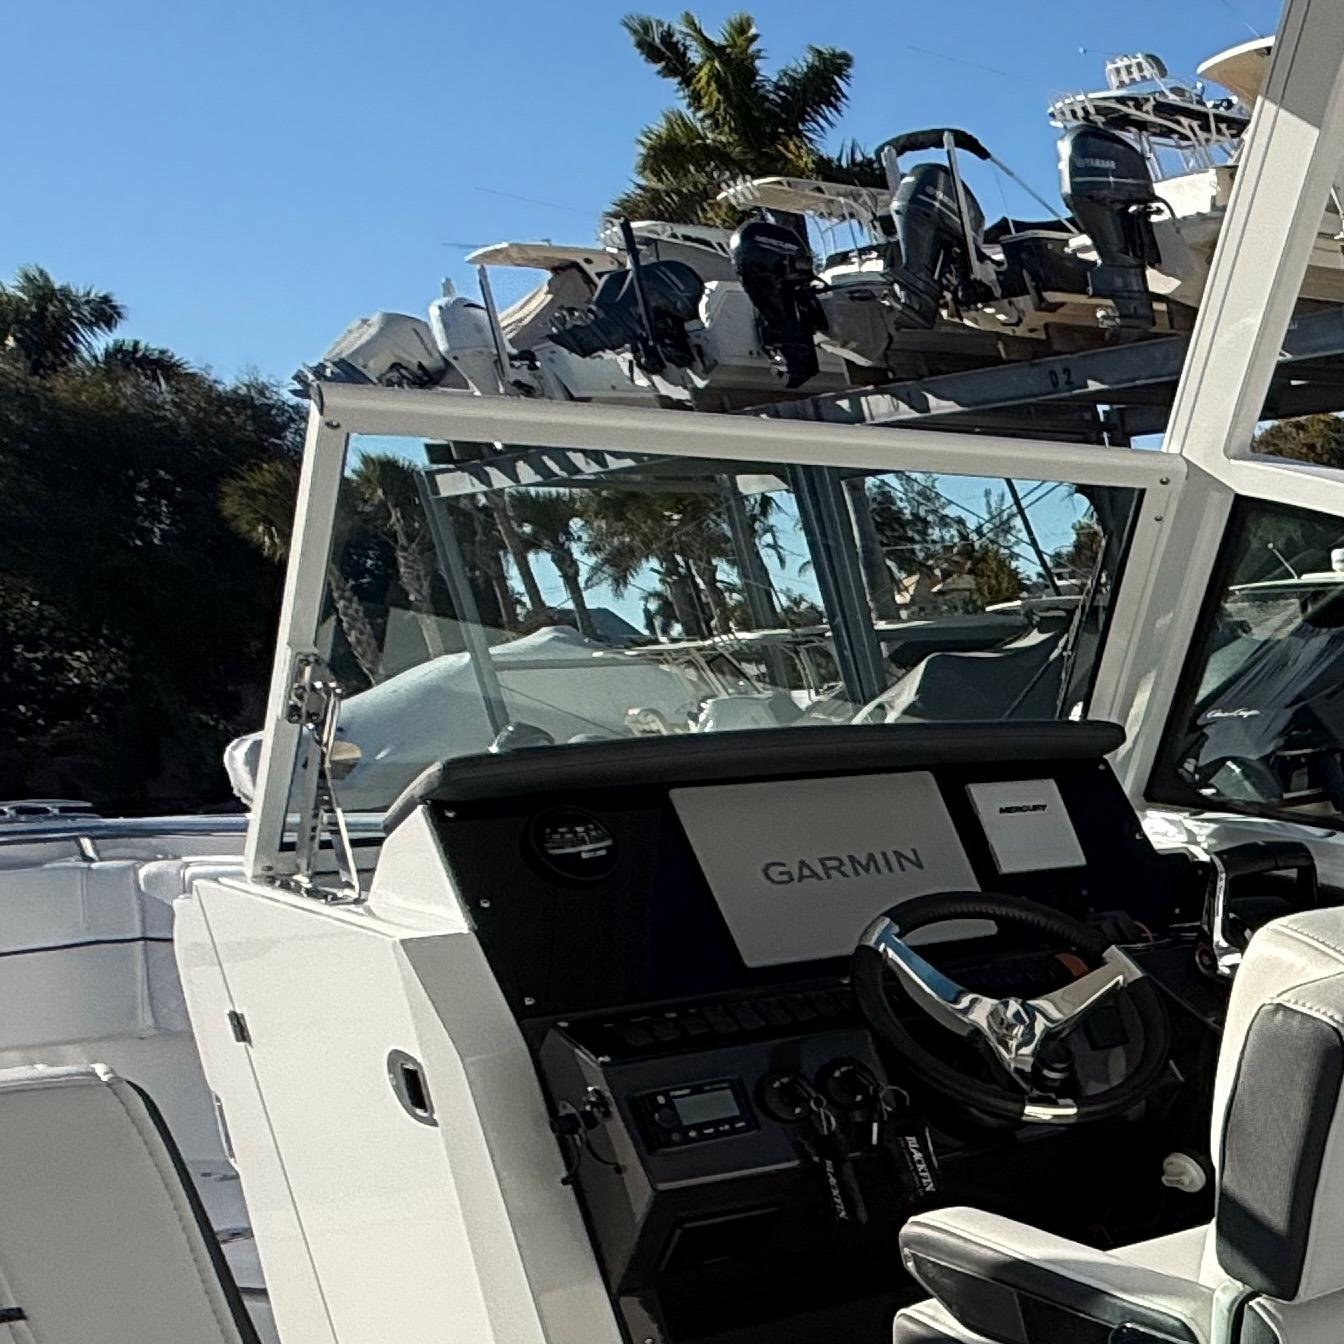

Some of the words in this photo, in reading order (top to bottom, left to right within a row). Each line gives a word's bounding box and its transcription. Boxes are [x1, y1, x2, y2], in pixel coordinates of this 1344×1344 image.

[999, 804, 1048, 815] MERCURY
[762, 847, 925, 885] GARMIN
[905, 1136, 936, 1192] BLACKFIN
